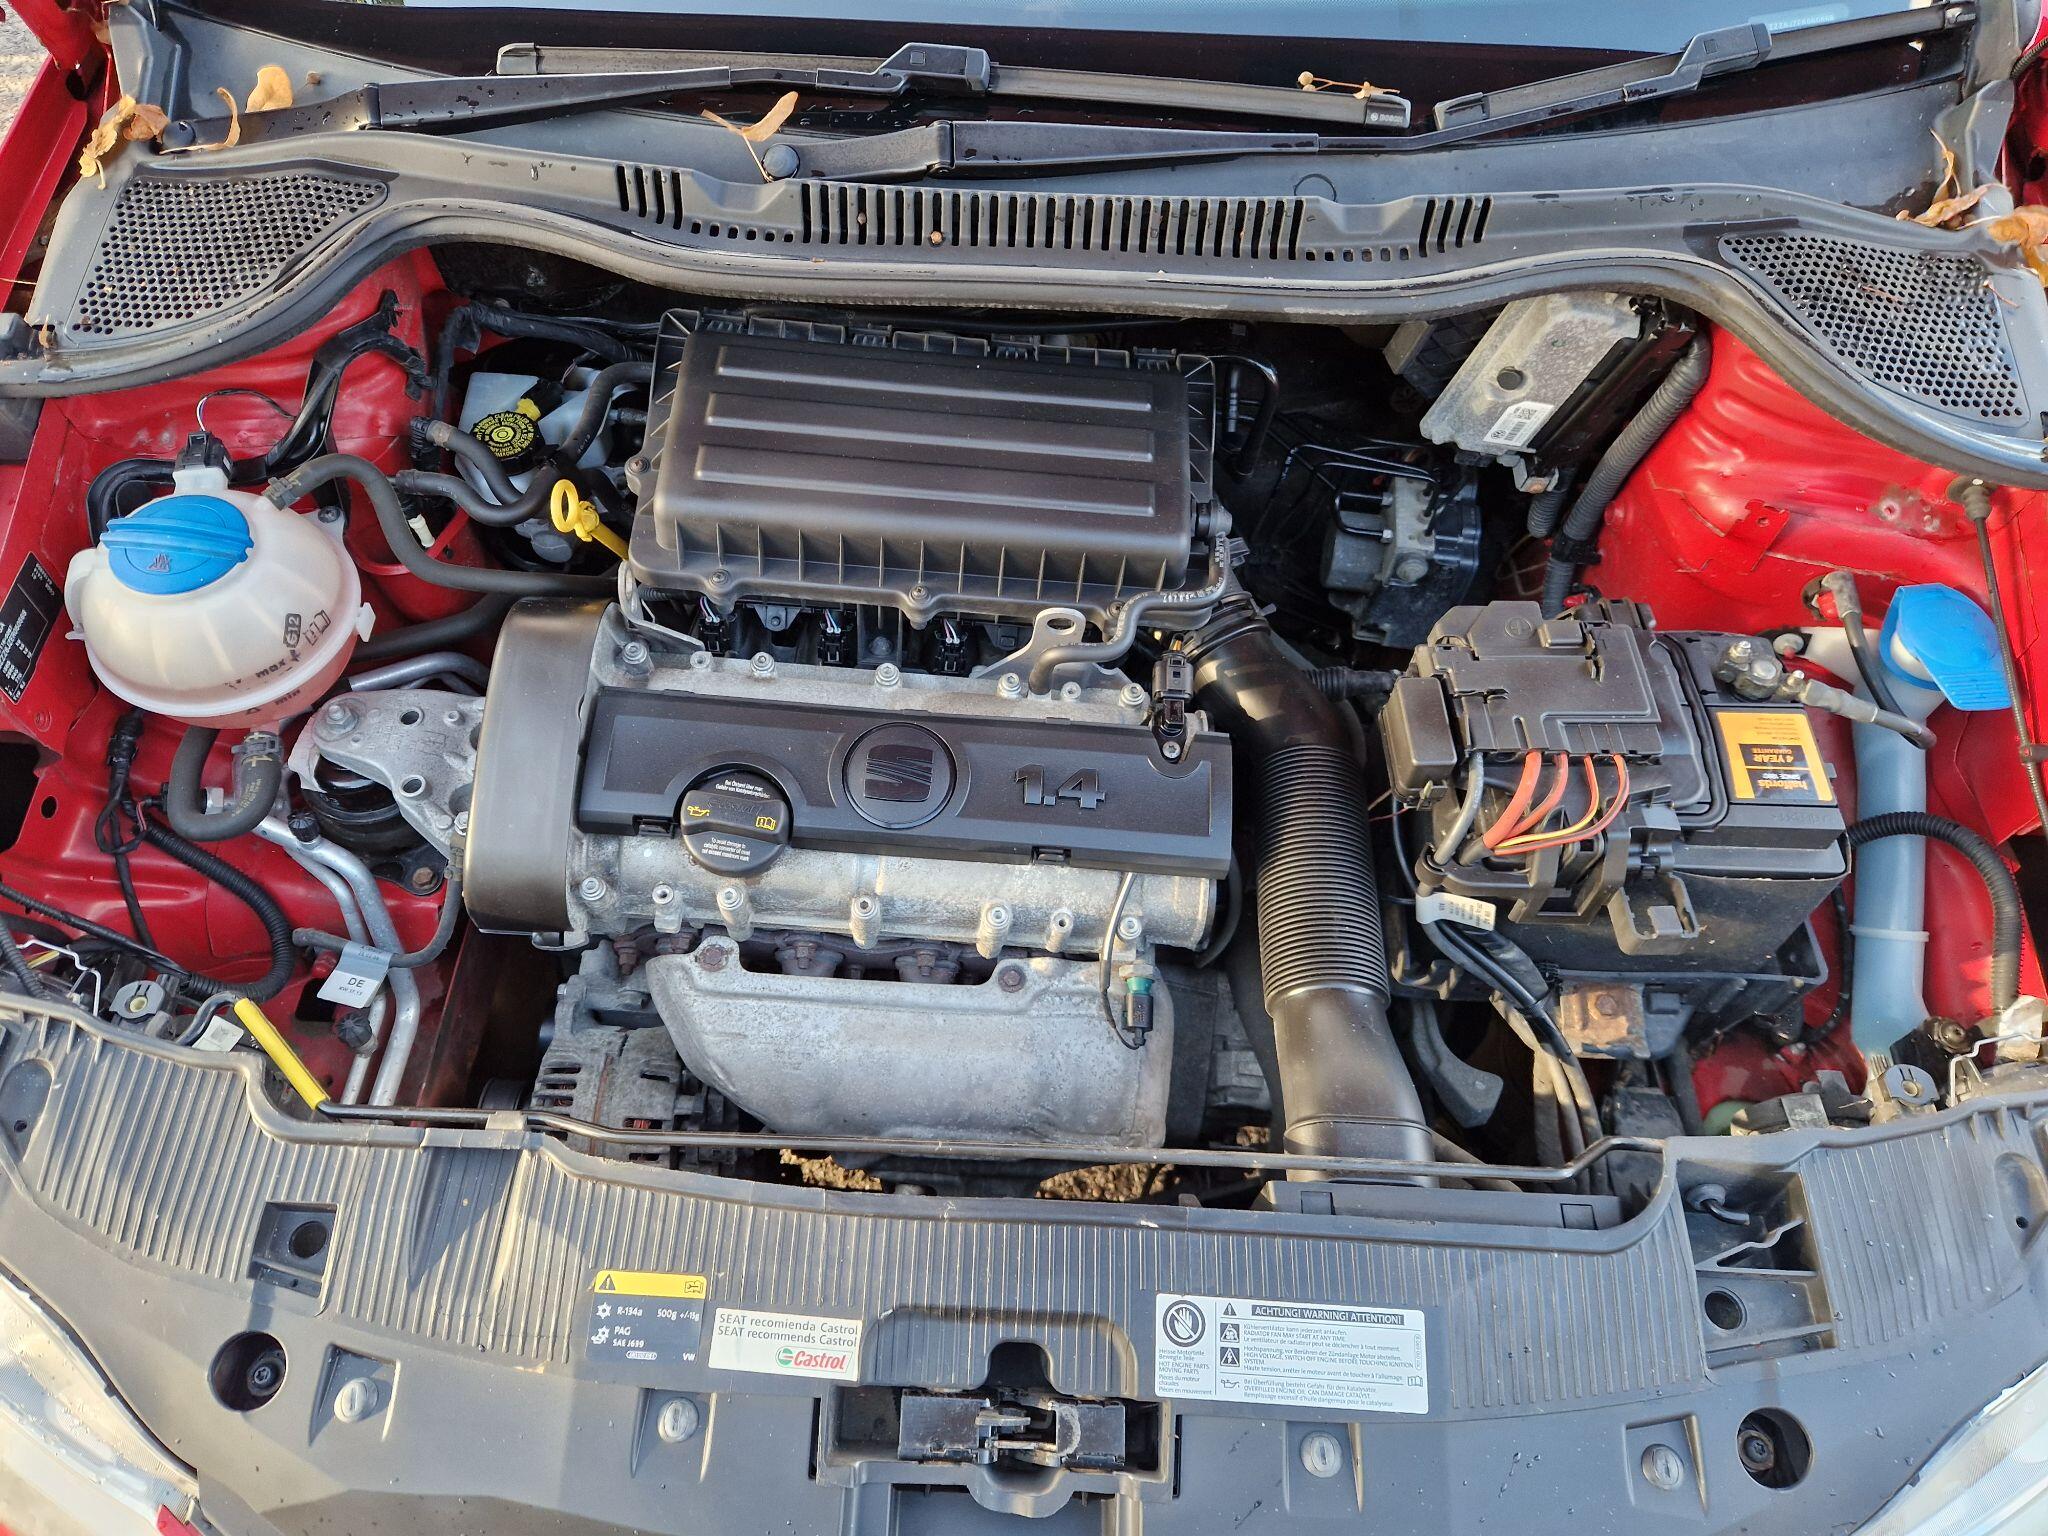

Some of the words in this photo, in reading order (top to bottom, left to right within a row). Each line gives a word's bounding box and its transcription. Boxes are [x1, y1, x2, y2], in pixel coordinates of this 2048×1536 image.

[286, 616, 300, 646] G12
[255, 658, 286, 678] max
[1753, 754, 1786, 764] YEAR
[1015, 763, 1105, 809] 1.4
[347, 977, 366, 988] DE
[617, 1306, 643, 1316] R-134a
[657, 1309, 677, 1320] 500g
[1255, 1306, 1302, 1318] ACHTUNG!
[1303, 1309, 1349, 1320] WARNING!
[1350, 1312, 1402, 1324] ATTENTION!
[614, 1326, 631, 1336] PAG
[719, 1313, 748, 1326] SEAT
[751, 1318, 816, 1332] recomienda
[820, 1322, 858, 1336] Castrol
[612, 1339, 626, 1347] SAE
[718, 1326, 746, 1338] SEAT
[748, 1330, 816, 1344] recommends
[819, 1335, 857, 1348] Castrol
[683, 1353, 696, 1361] VW
[793, 1350, 848, 1370] Castrol
